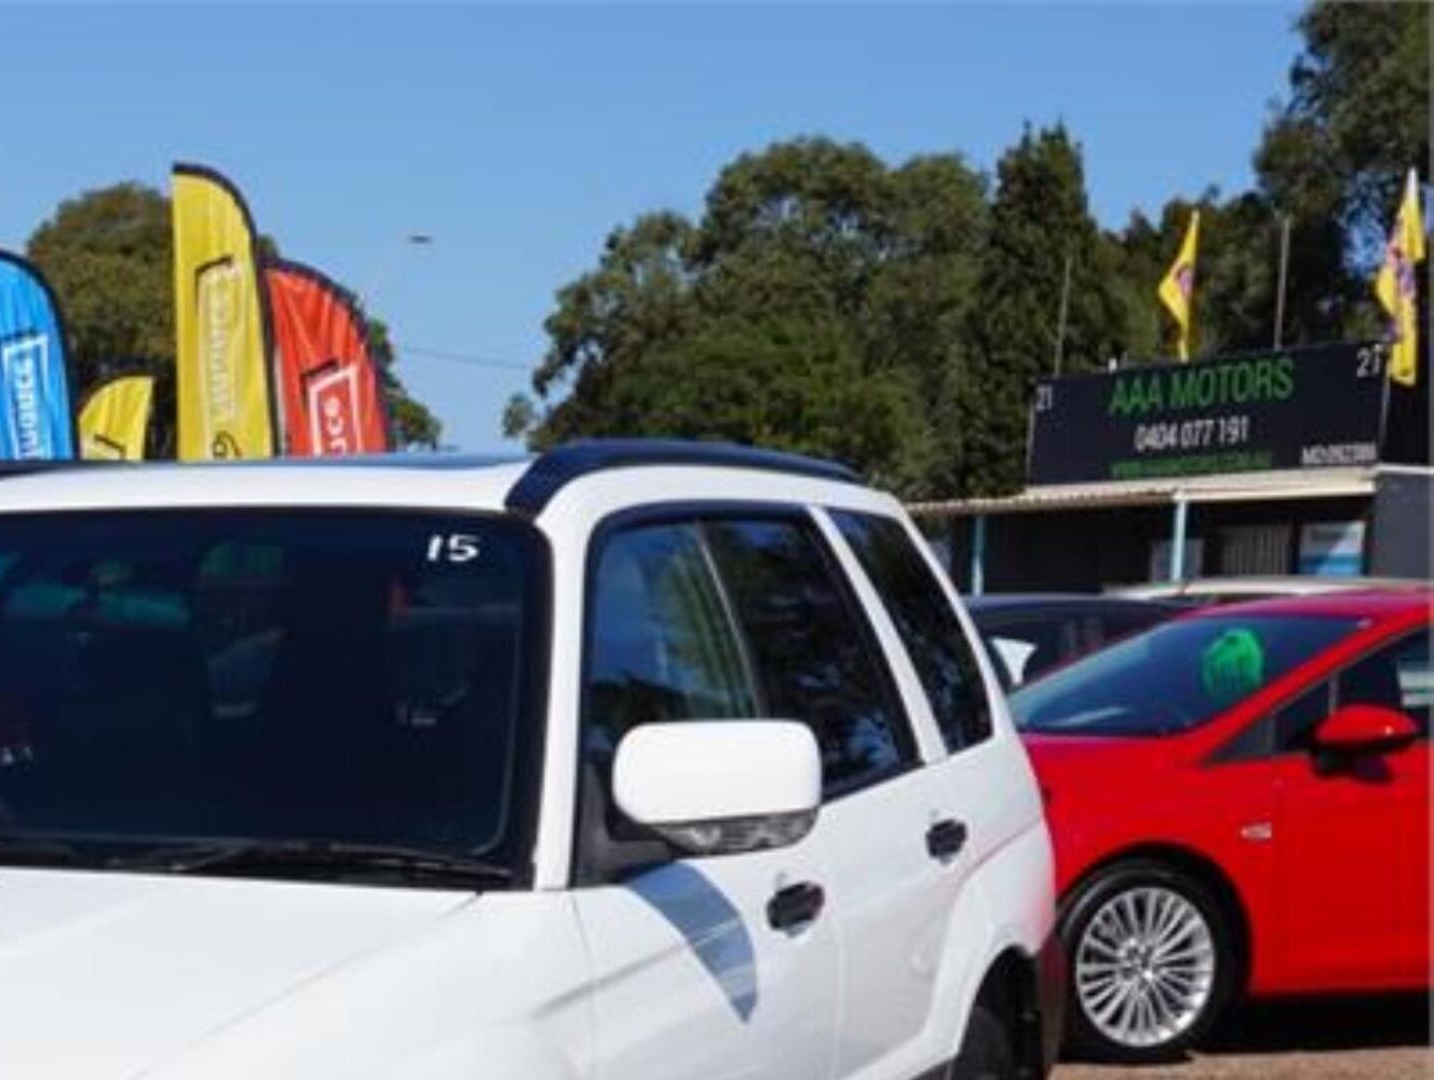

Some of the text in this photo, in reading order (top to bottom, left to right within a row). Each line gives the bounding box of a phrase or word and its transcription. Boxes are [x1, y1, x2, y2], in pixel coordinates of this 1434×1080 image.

[1108, 356, 1294, 414] AAA MOTORS
[1219, 415, 1249, 445] 191
[427, 534, 480, 561] 15
